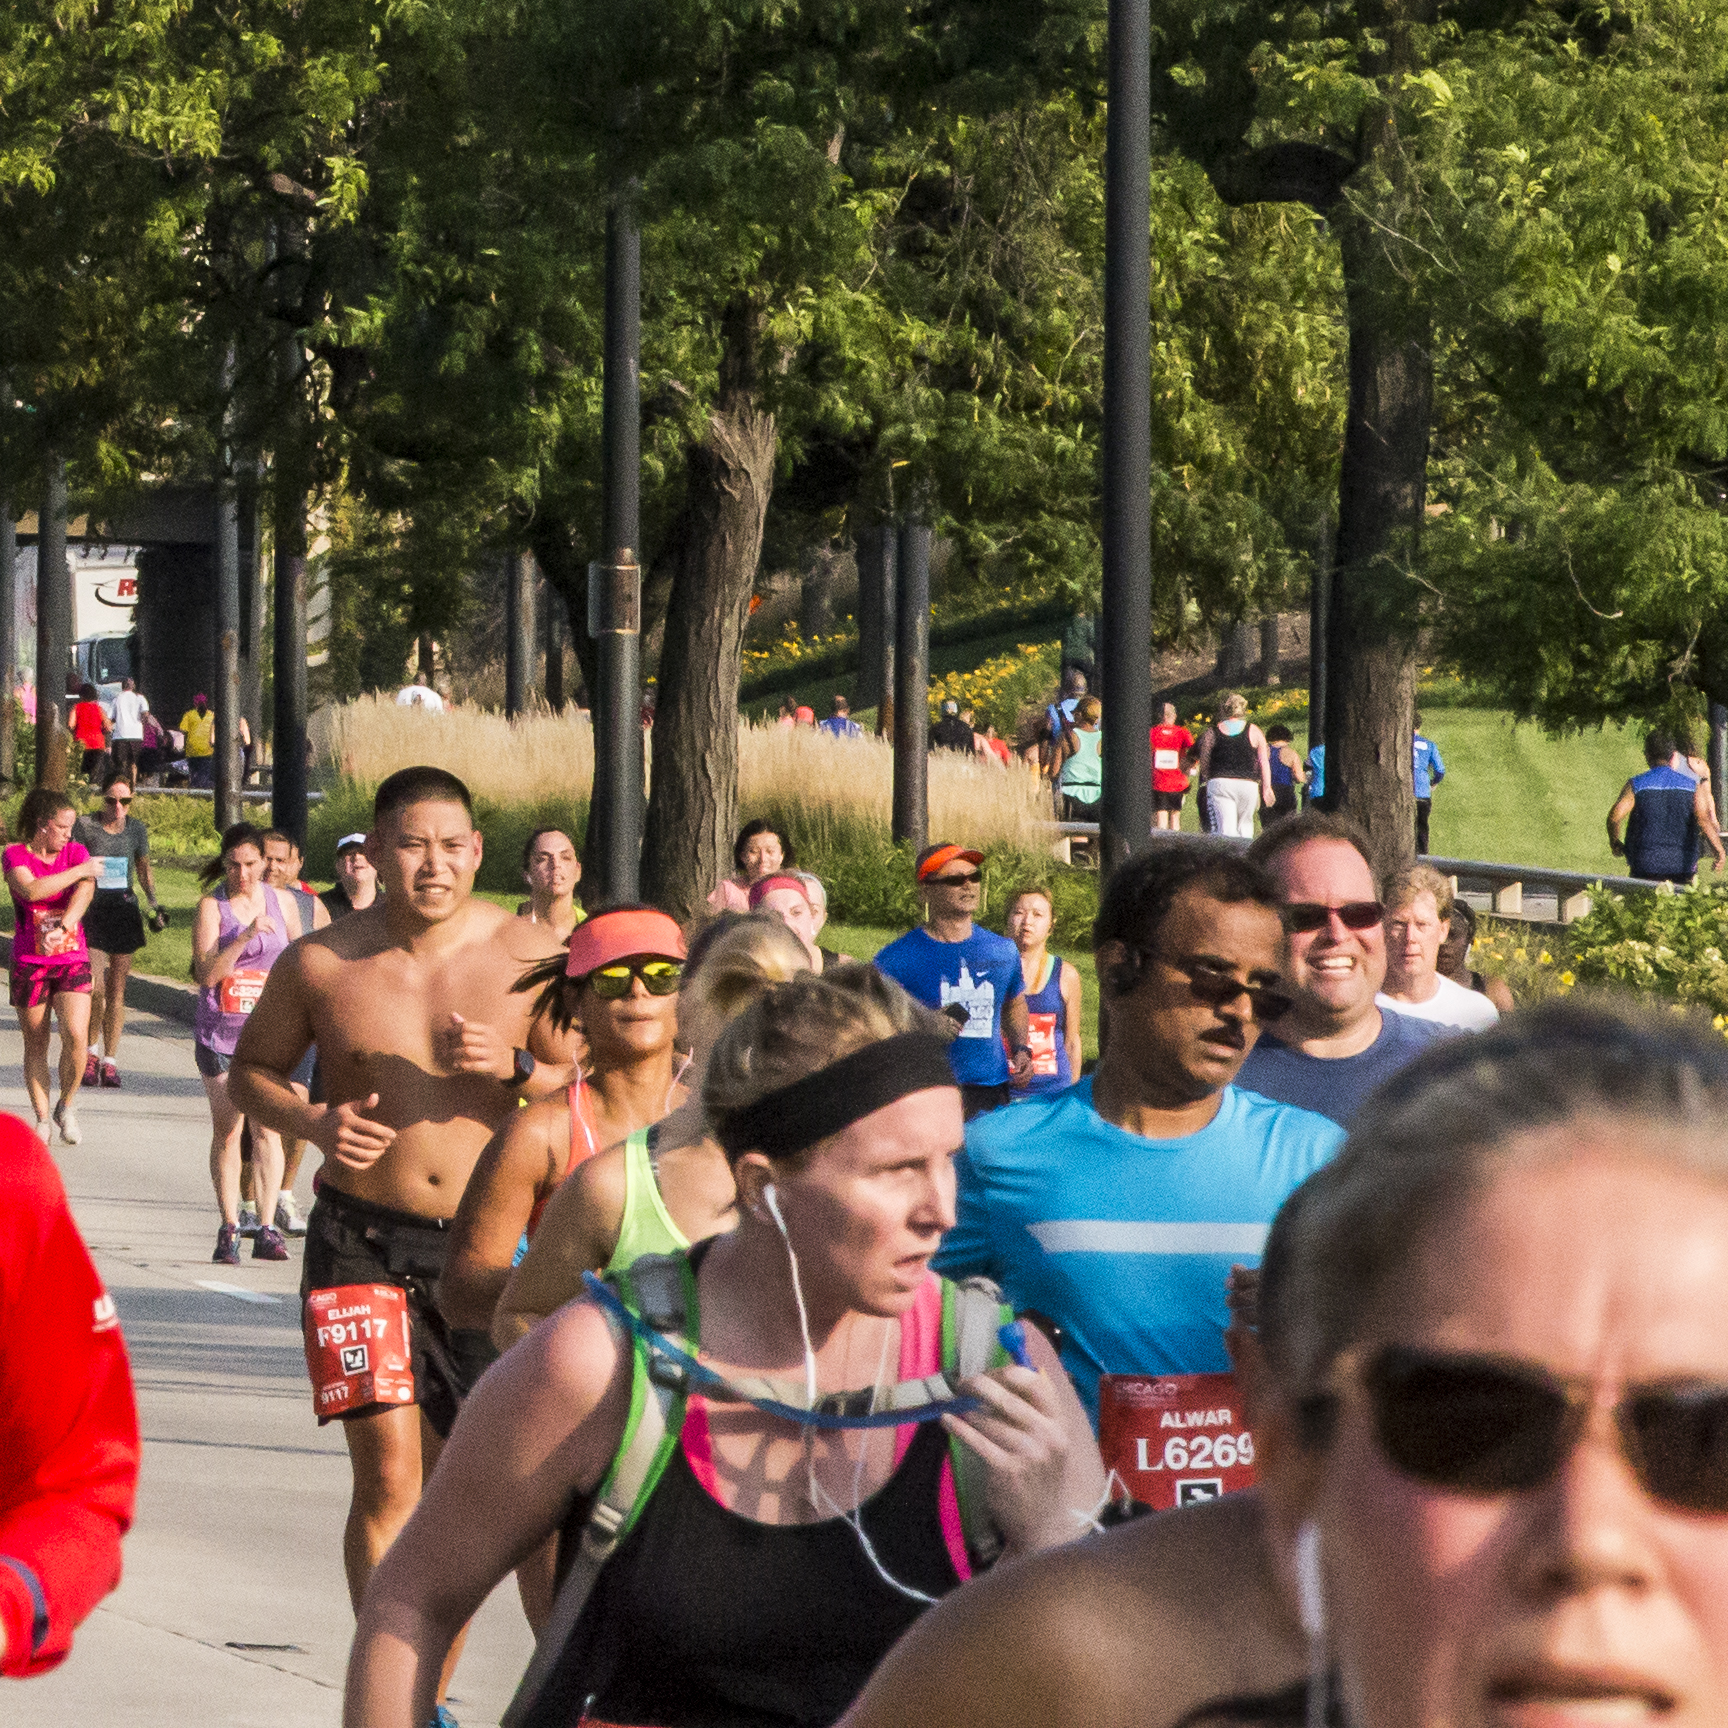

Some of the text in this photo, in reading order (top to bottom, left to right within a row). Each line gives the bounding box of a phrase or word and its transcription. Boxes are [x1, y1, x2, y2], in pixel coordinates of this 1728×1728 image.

[328, 1305, 371, 1320] ELIJAH
[317, 1318, 388, 1347] F9117
[1160, 1408, 1233, 1428] ALWAR
[1136, 1431, 1255, 1471] L6269
